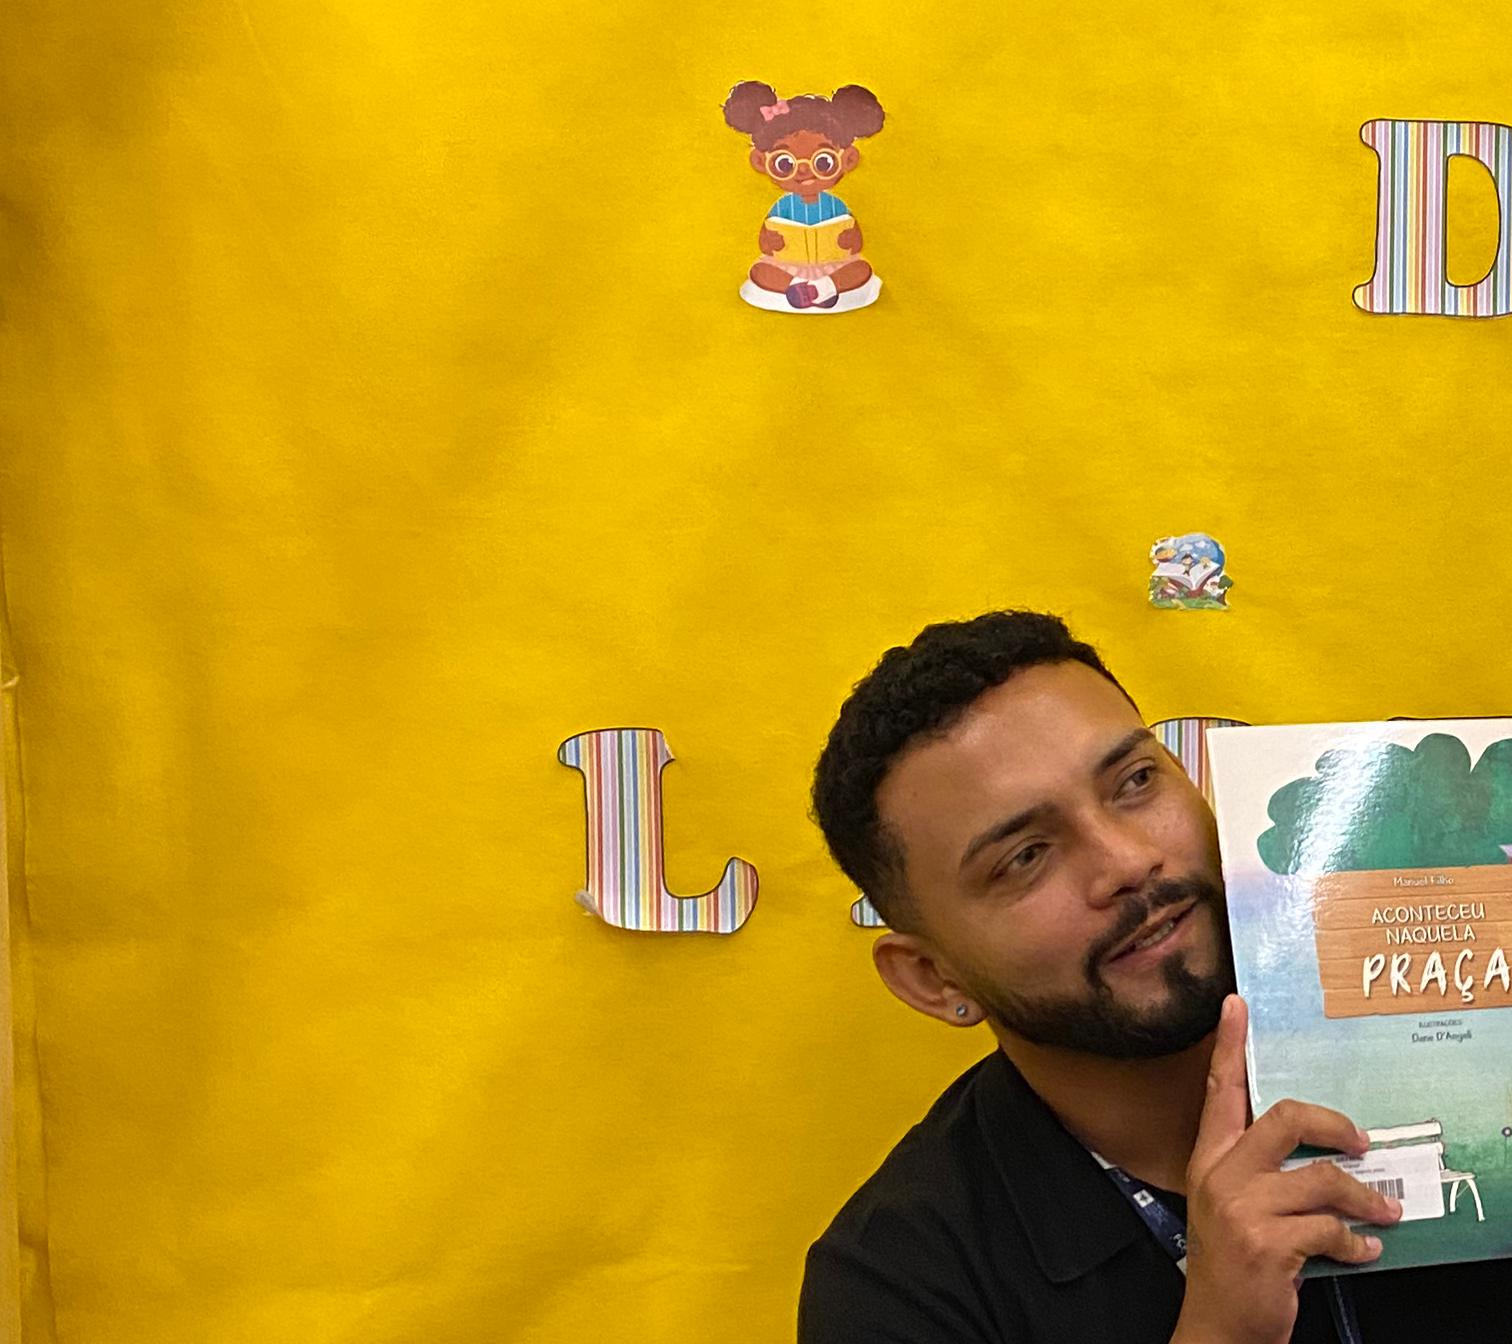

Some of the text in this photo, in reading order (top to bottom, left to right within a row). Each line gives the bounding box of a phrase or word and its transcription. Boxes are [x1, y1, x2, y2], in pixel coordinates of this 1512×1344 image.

[1393, 876, 1428, 887] Manuel
[1371, 902, 1486, 925] ACONTECEU
[1386, 924, 1476, 945] NAQUELA
[1362, 946, 1511, 1003] PRAÇA
